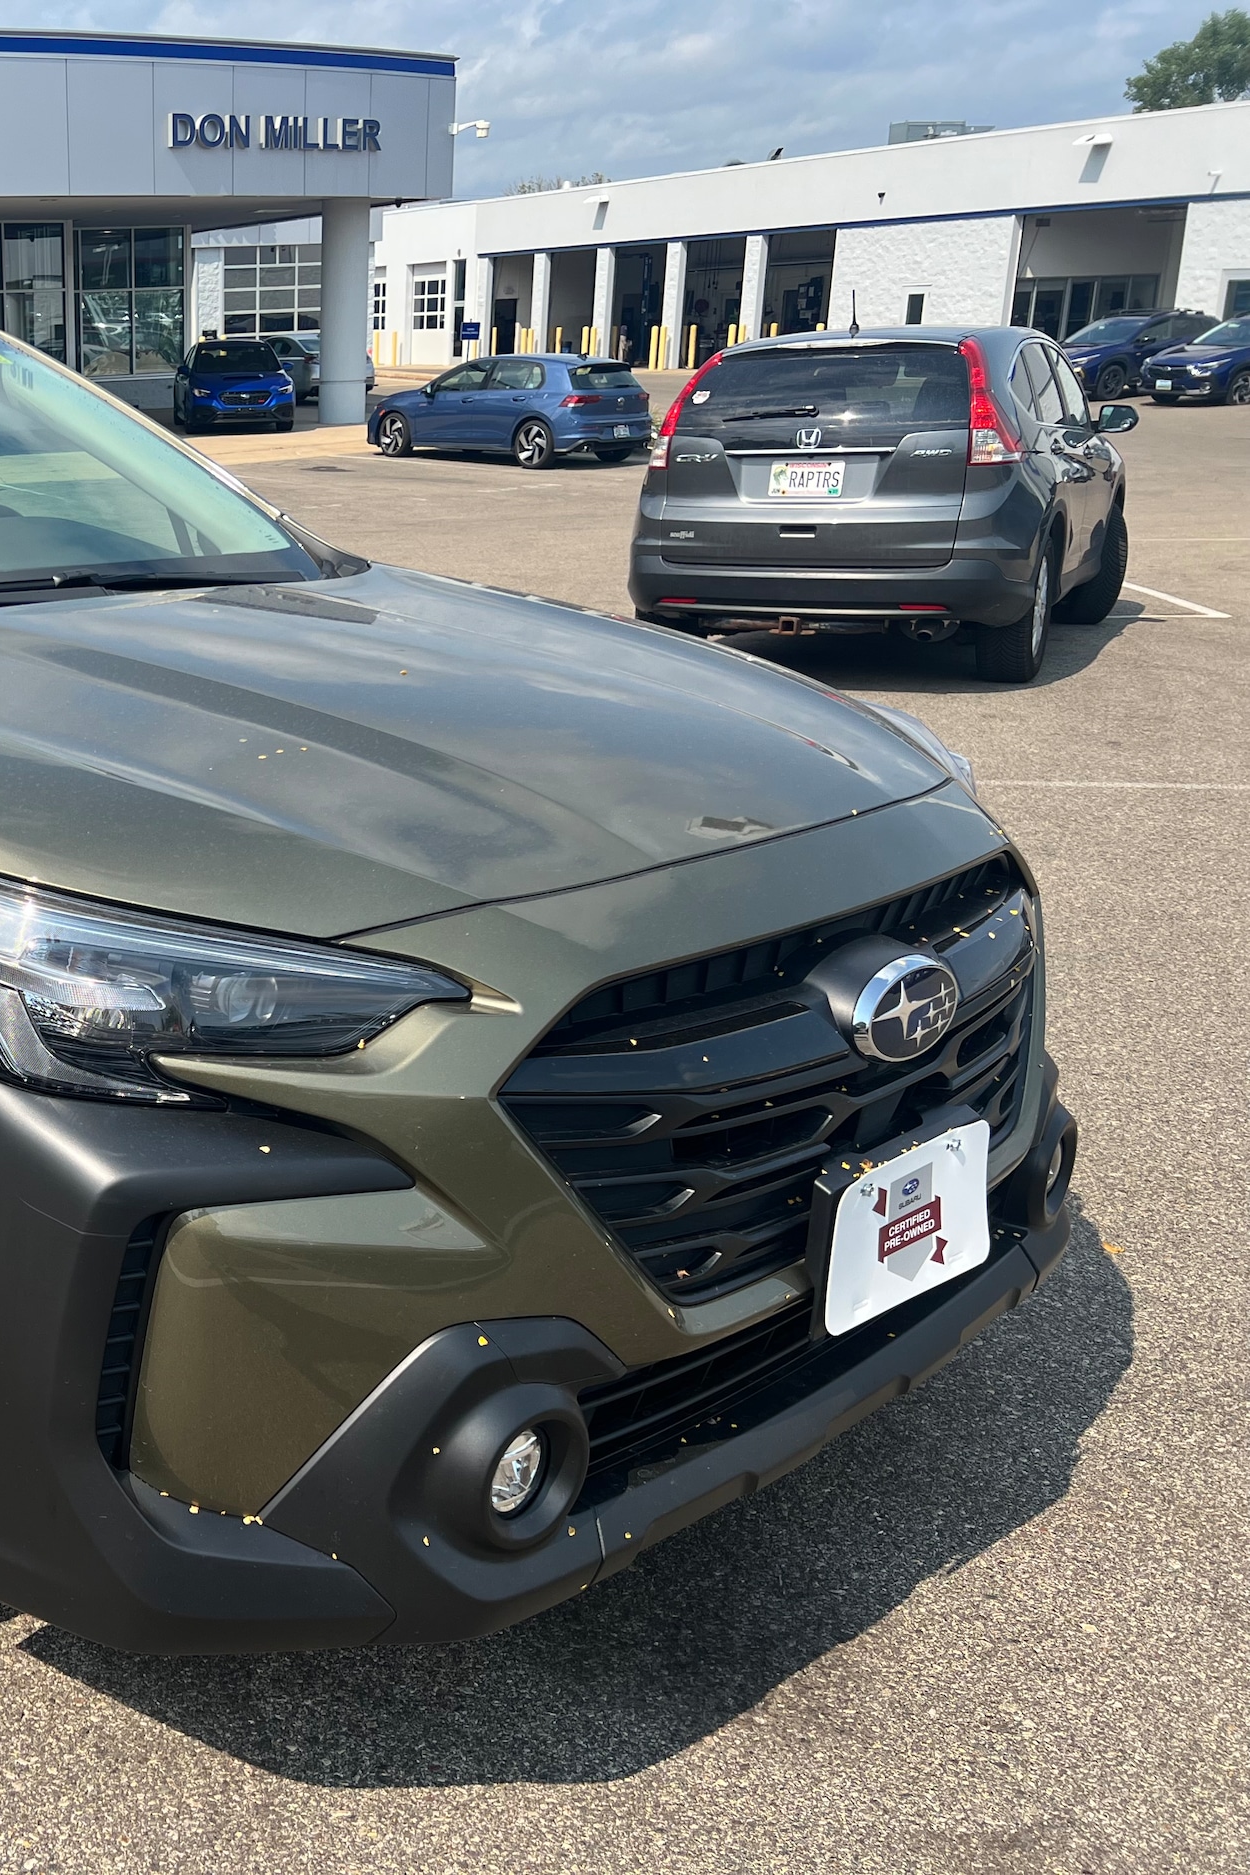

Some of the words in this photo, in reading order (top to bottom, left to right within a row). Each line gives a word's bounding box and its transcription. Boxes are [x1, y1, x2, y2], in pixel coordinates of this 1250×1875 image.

[168, 113, 251, 149] DON
[261, 115, 382, 151] MILLER
[909, 448, 953, 458] AWD
[789, 471, 841, 488] RAPTRS
[899, 1194, 921, 1209] SUBARU
[888, 1209, 930, 1236] CERTIFIED
[884, 1219, 935, 1251] PRE-OWNED
